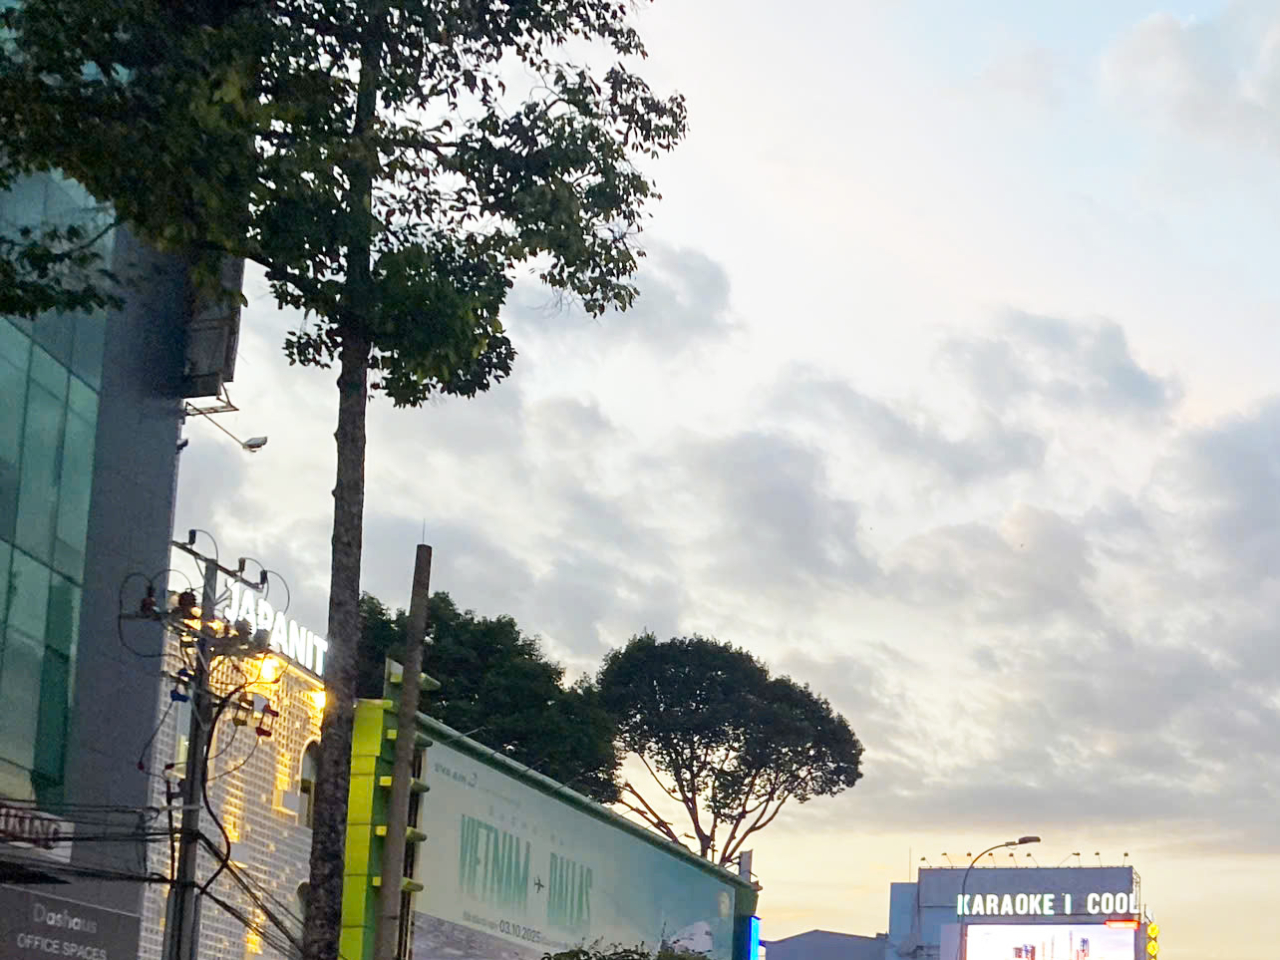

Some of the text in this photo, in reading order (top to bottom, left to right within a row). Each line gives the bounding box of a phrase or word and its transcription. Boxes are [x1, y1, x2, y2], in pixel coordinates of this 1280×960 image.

[957, 893, 1055, 916] KARAOKE
[1087, 892, 1140, 914] COOL
[17, 933, 60, 954] OFFICE
